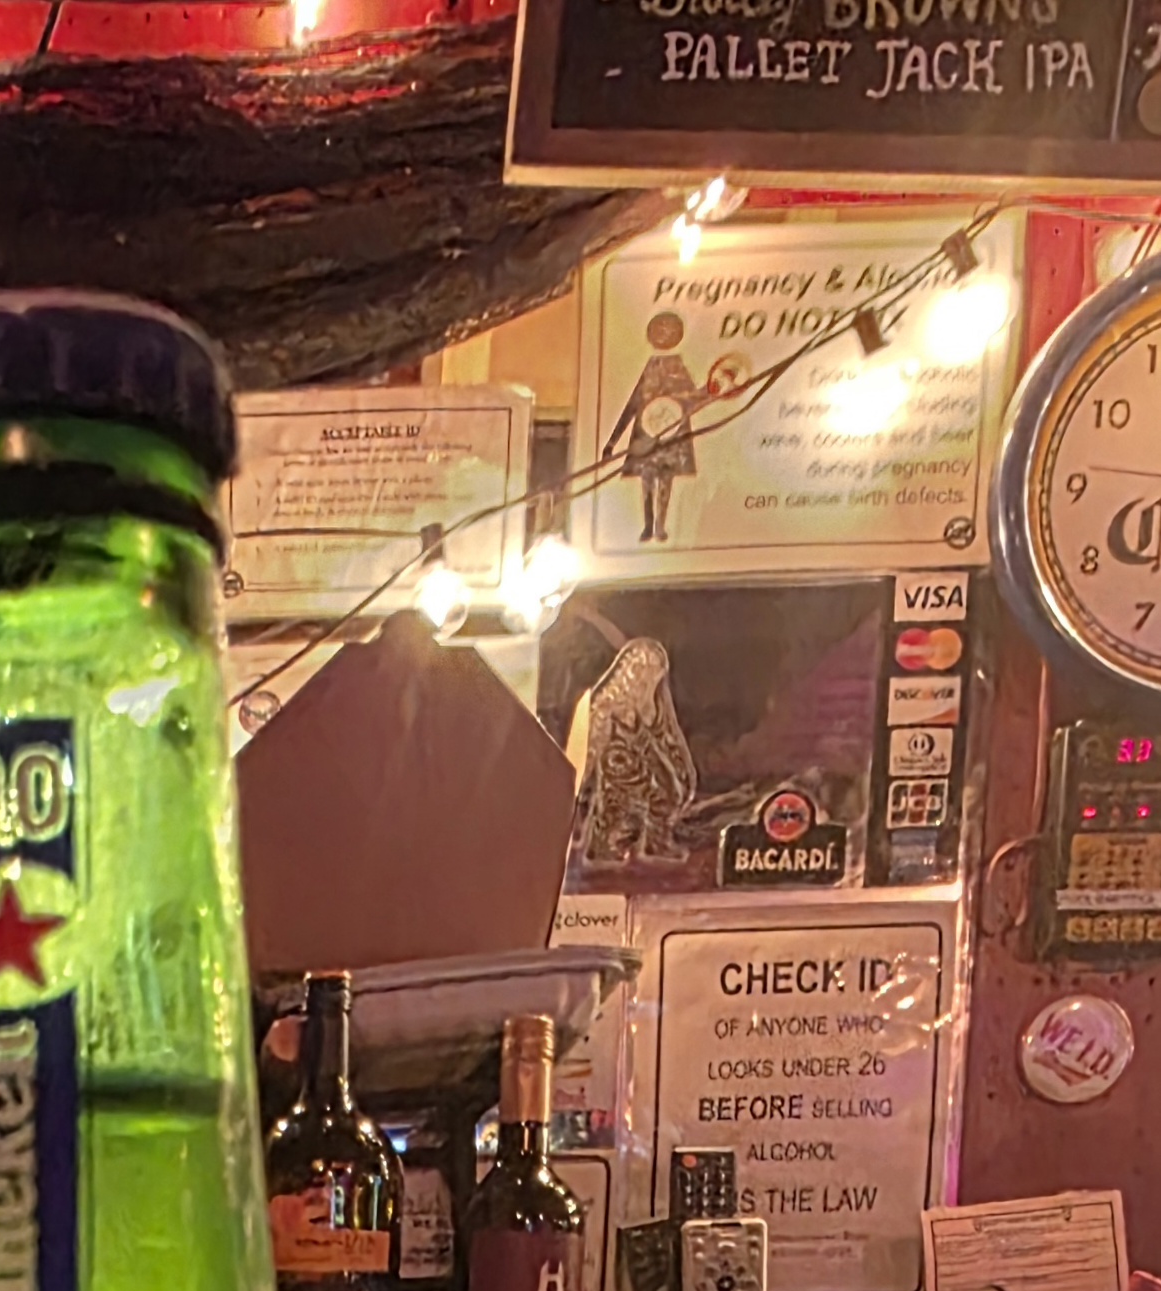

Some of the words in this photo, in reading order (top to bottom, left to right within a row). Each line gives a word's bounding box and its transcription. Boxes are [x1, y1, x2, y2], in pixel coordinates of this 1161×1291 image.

[661, 32, 851, 82] PALLET
[867, 38, 1003, 97] JACK
[1026, 42, 1094, 90] IPA
[654, 270, 817, 305] Pregnancy
[824, 264, 845, 288] &
[719, 312, 768, 339] DO
[1094, 398, 1131, 430] 10
[744, 491, 779, 510] can
[1066, 472, 1088, 504] 9
[1080, 544, 1099, 577] 8
[904, 585, 964, 610] VISA
[1135, 601, 1156, 633] 7
[564, 911, 619, 930] clover
[719, 960, 846, 996] CHECK
[859, 959, 894, 992] ID
[714, 1018, 739, 1039] OF
[746, 1016, 828, 1037] ANYONE
[837, 1014, 885, 1033] WHO
[707, 1060, 775, 1081] LOOKS
[781, 1058, 850, 1080] UNDER
[858, 1051, 886, 1076] 26
[698, 1095, 804, 1122] BEFORE
[811, 1098, 893, 1118] SELLING
[745, 1142, 836, 1161] ALCOHOL
[765, 1187, 812, 1213] THE
[822, 1187, 878, 1213] LAW
